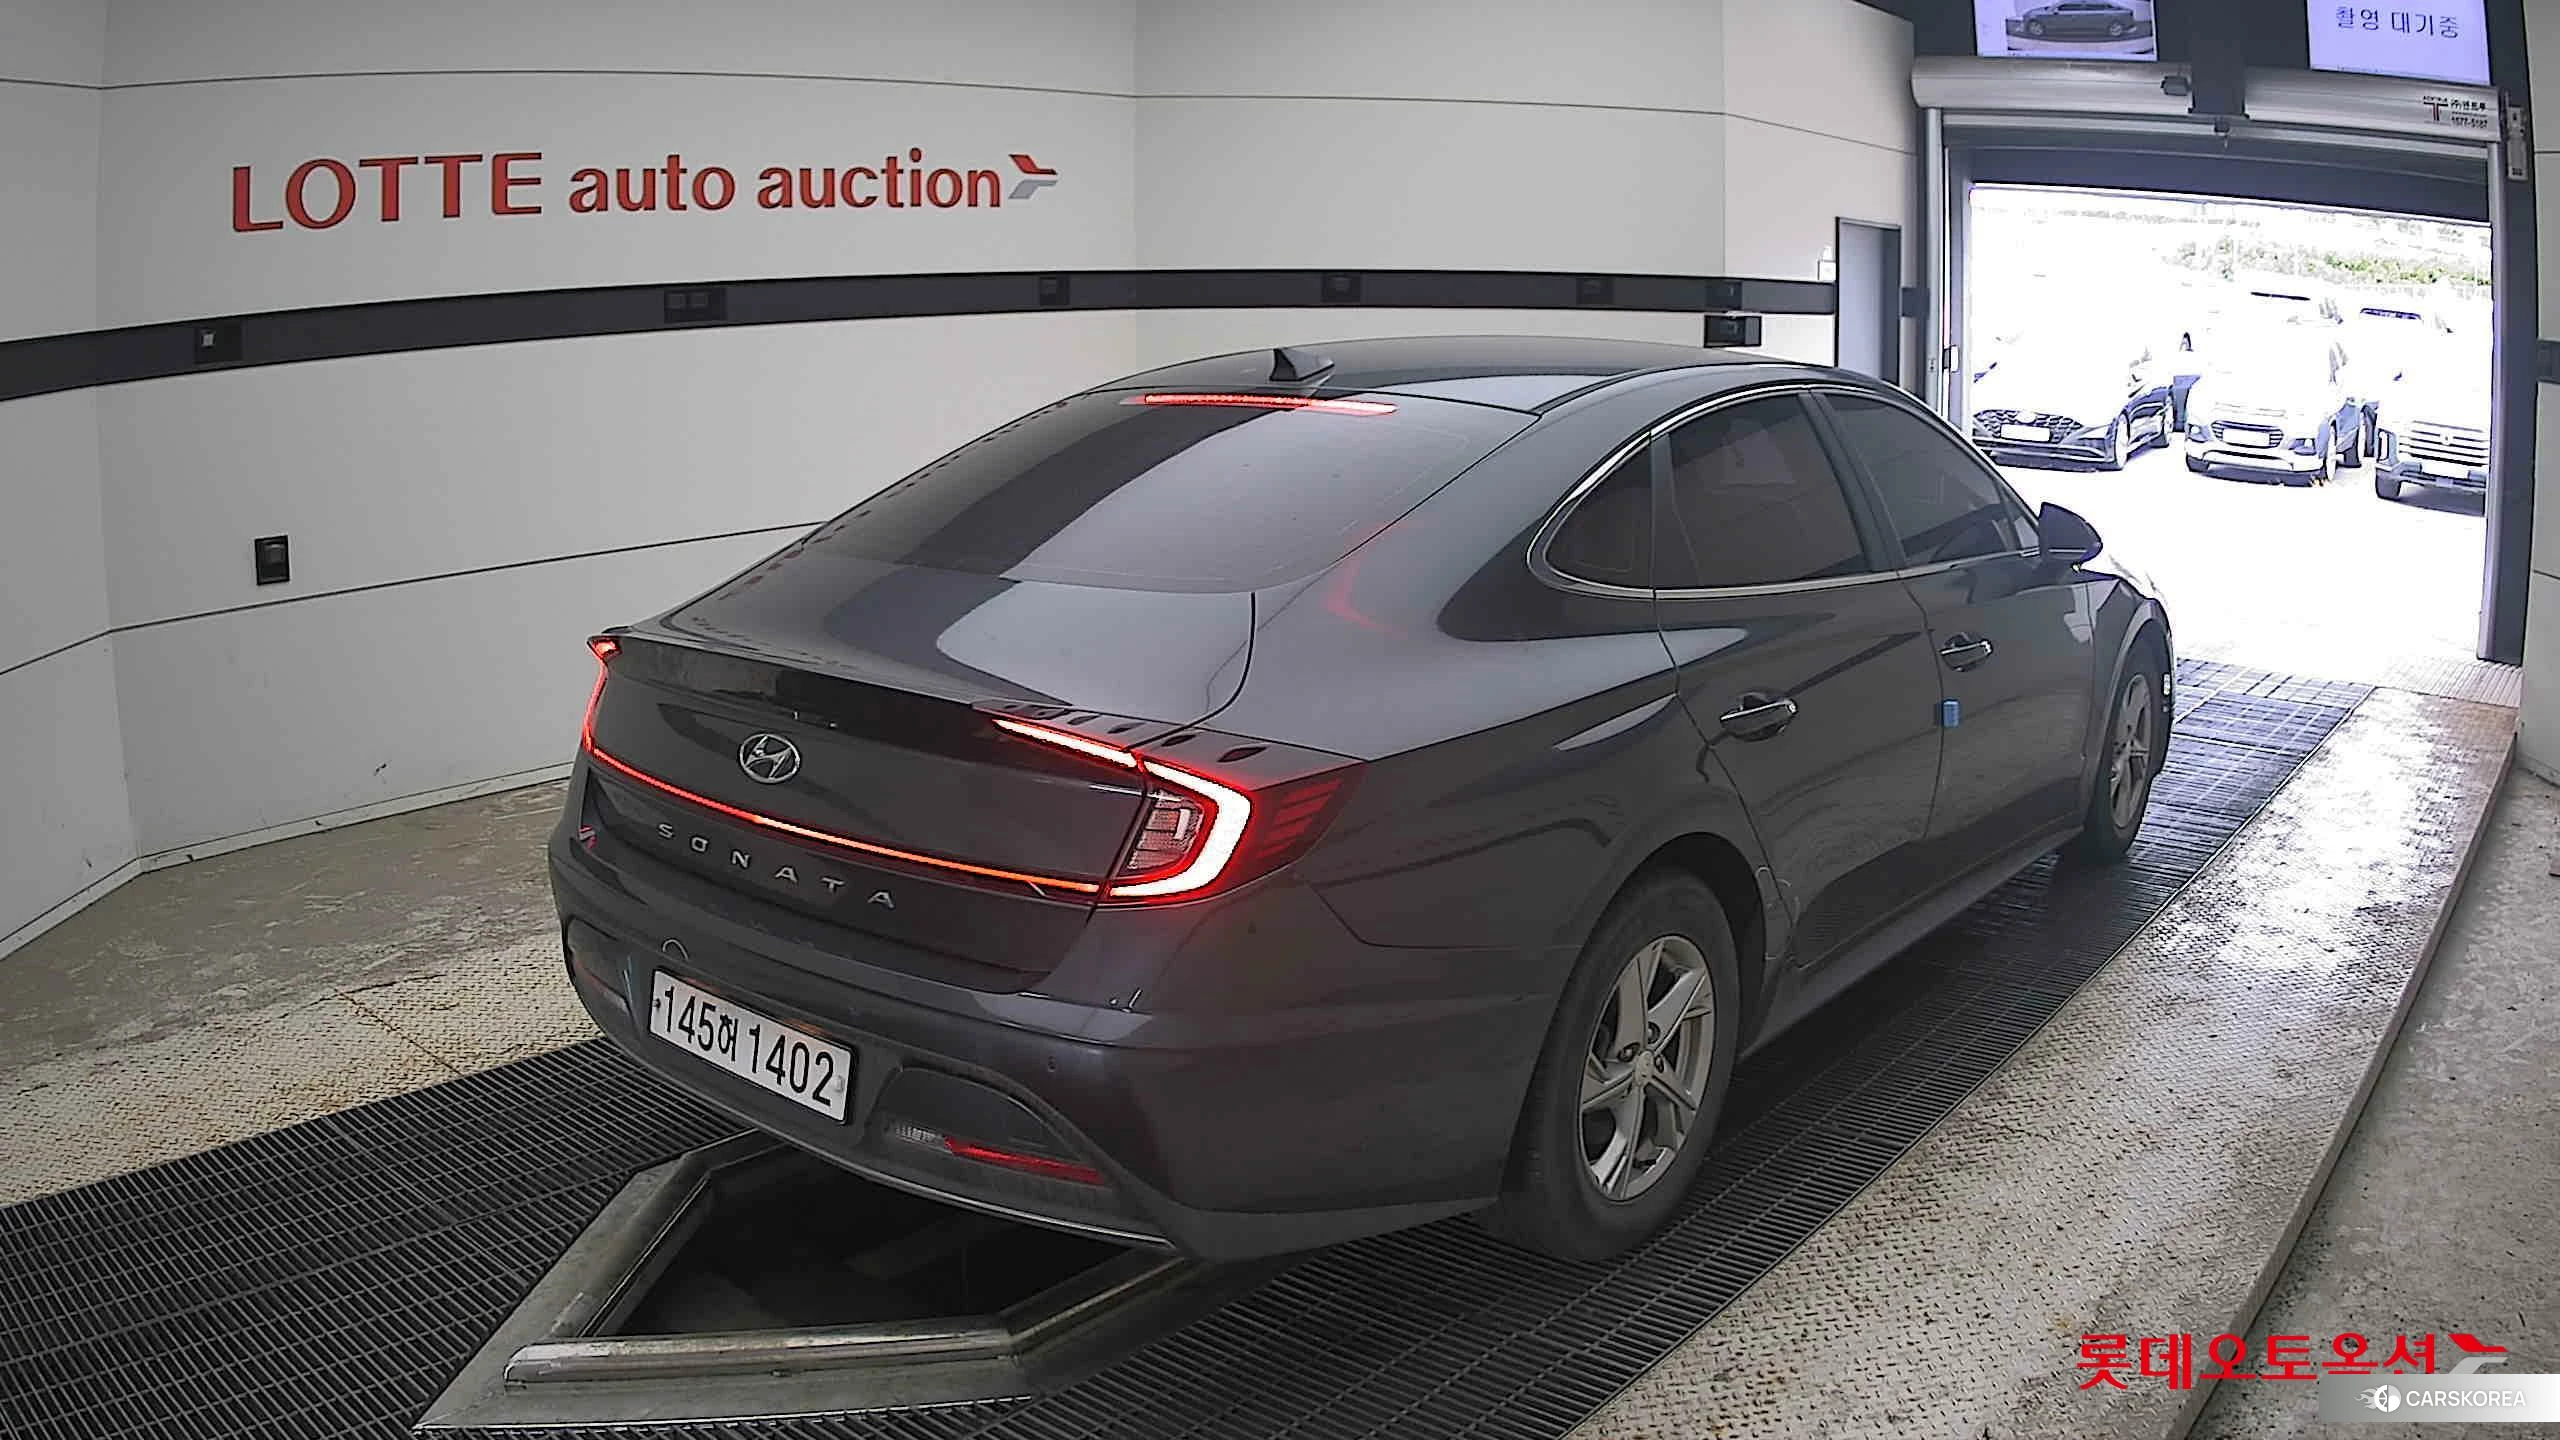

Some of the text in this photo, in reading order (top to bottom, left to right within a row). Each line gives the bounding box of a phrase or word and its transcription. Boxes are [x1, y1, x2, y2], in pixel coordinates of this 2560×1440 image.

[2336, 6, 2459, 39] 촬영 대기중
[232, 147, 1001, 232] LOTTE auto auction
[657, 822, 895, 909] SONATA
